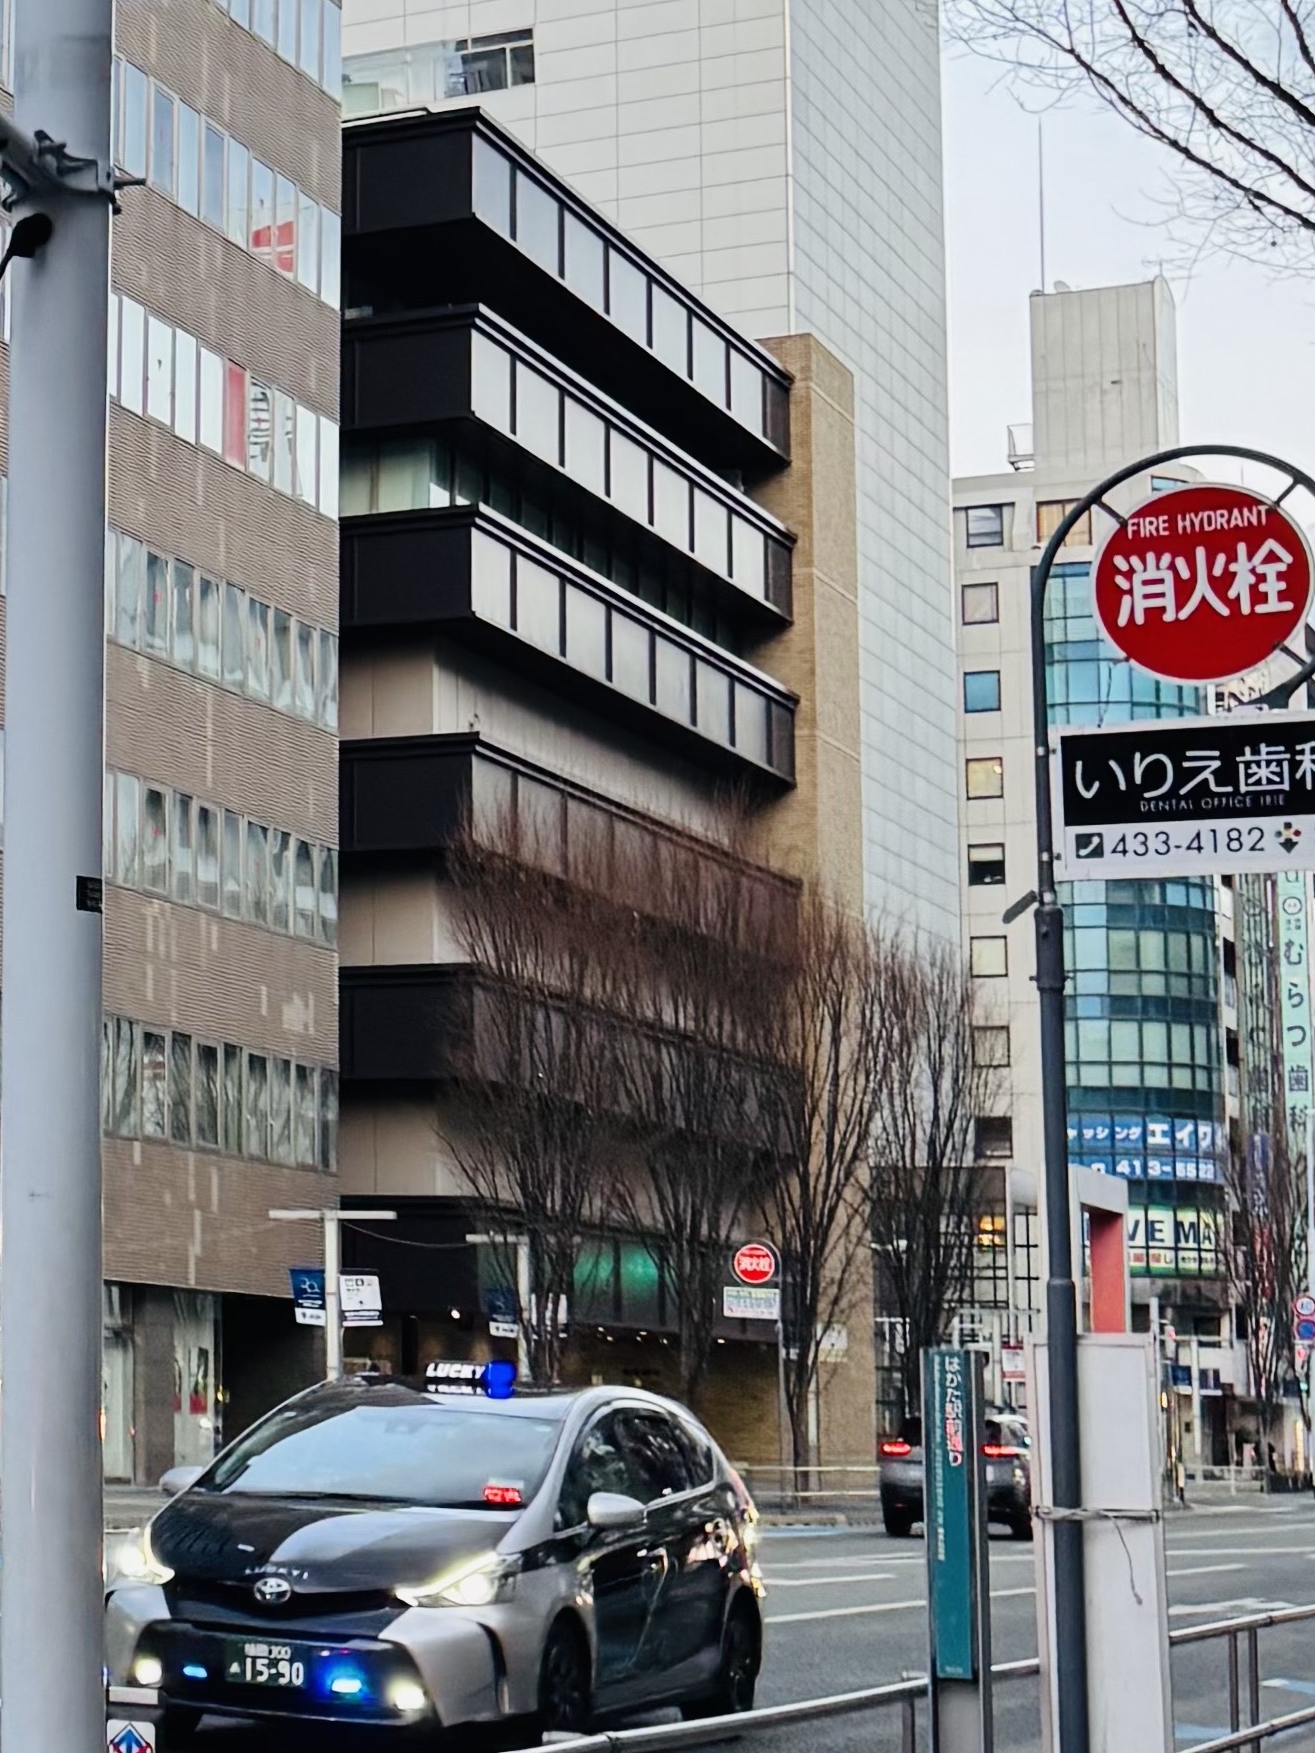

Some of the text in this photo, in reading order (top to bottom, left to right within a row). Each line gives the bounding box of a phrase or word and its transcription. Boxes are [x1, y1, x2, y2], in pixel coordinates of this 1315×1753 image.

[1127, 505, 1269, 539] FIRE HYDRANT
[1113, 538, 1294, 627] 消火栓
[1140, 798, 1193, 812] DENTAL
[1110, 826, 1266, 858] 433-4182
[1283, 938, 1310, 1133] むらつ歯科
[426, 1362, 486, 1379] LUCKY
[244, 1656, 305, 1686] 15-90
